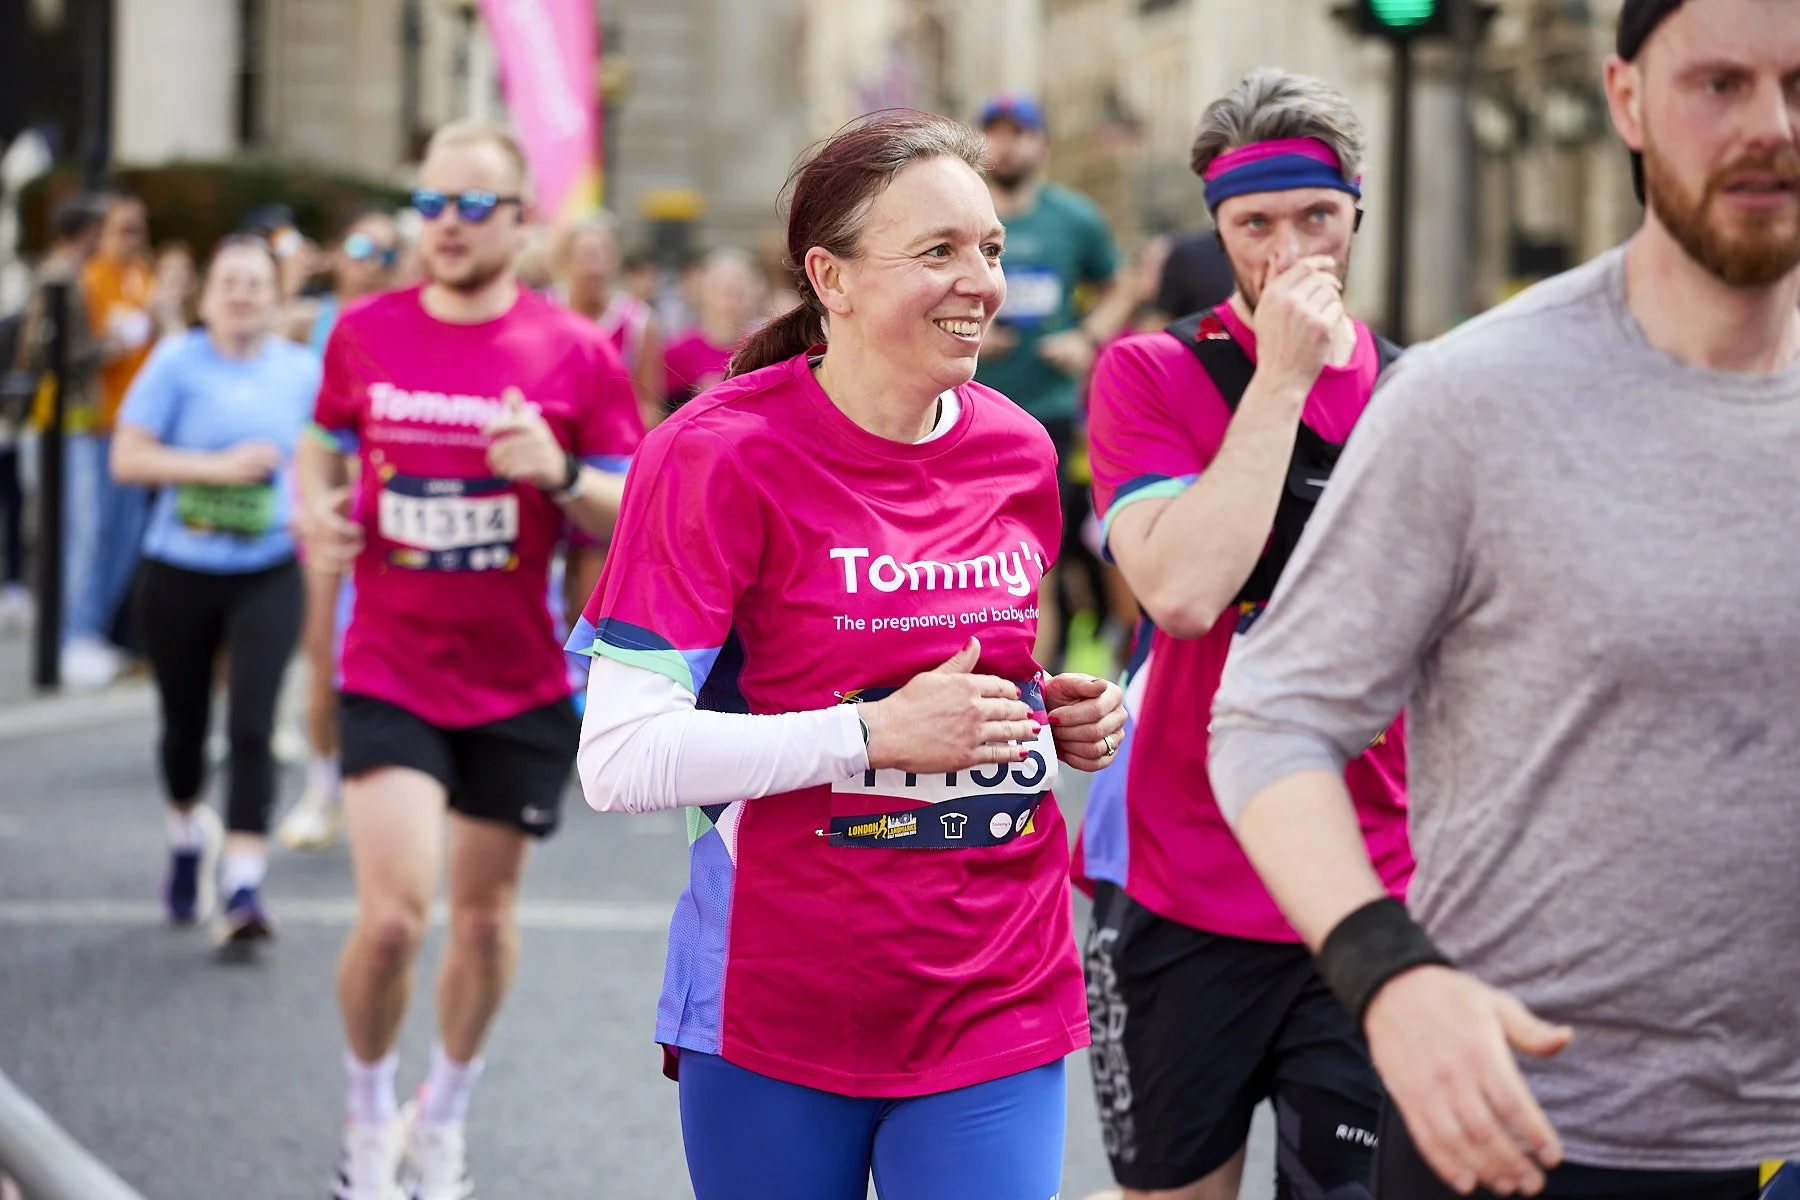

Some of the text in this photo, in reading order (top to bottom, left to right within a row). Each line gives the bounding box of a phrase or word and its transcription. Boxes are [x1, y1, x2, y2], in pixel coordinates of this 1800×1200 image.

[367, 381, 542, 431] Tommy
[833, 614, 866, 631] The
[872, 611, 956, 633] pregnancy
[960, 607, 988, 624] and
[990, 604, 1024, 623] baby
[847, 821, 879, 837] LONDON
